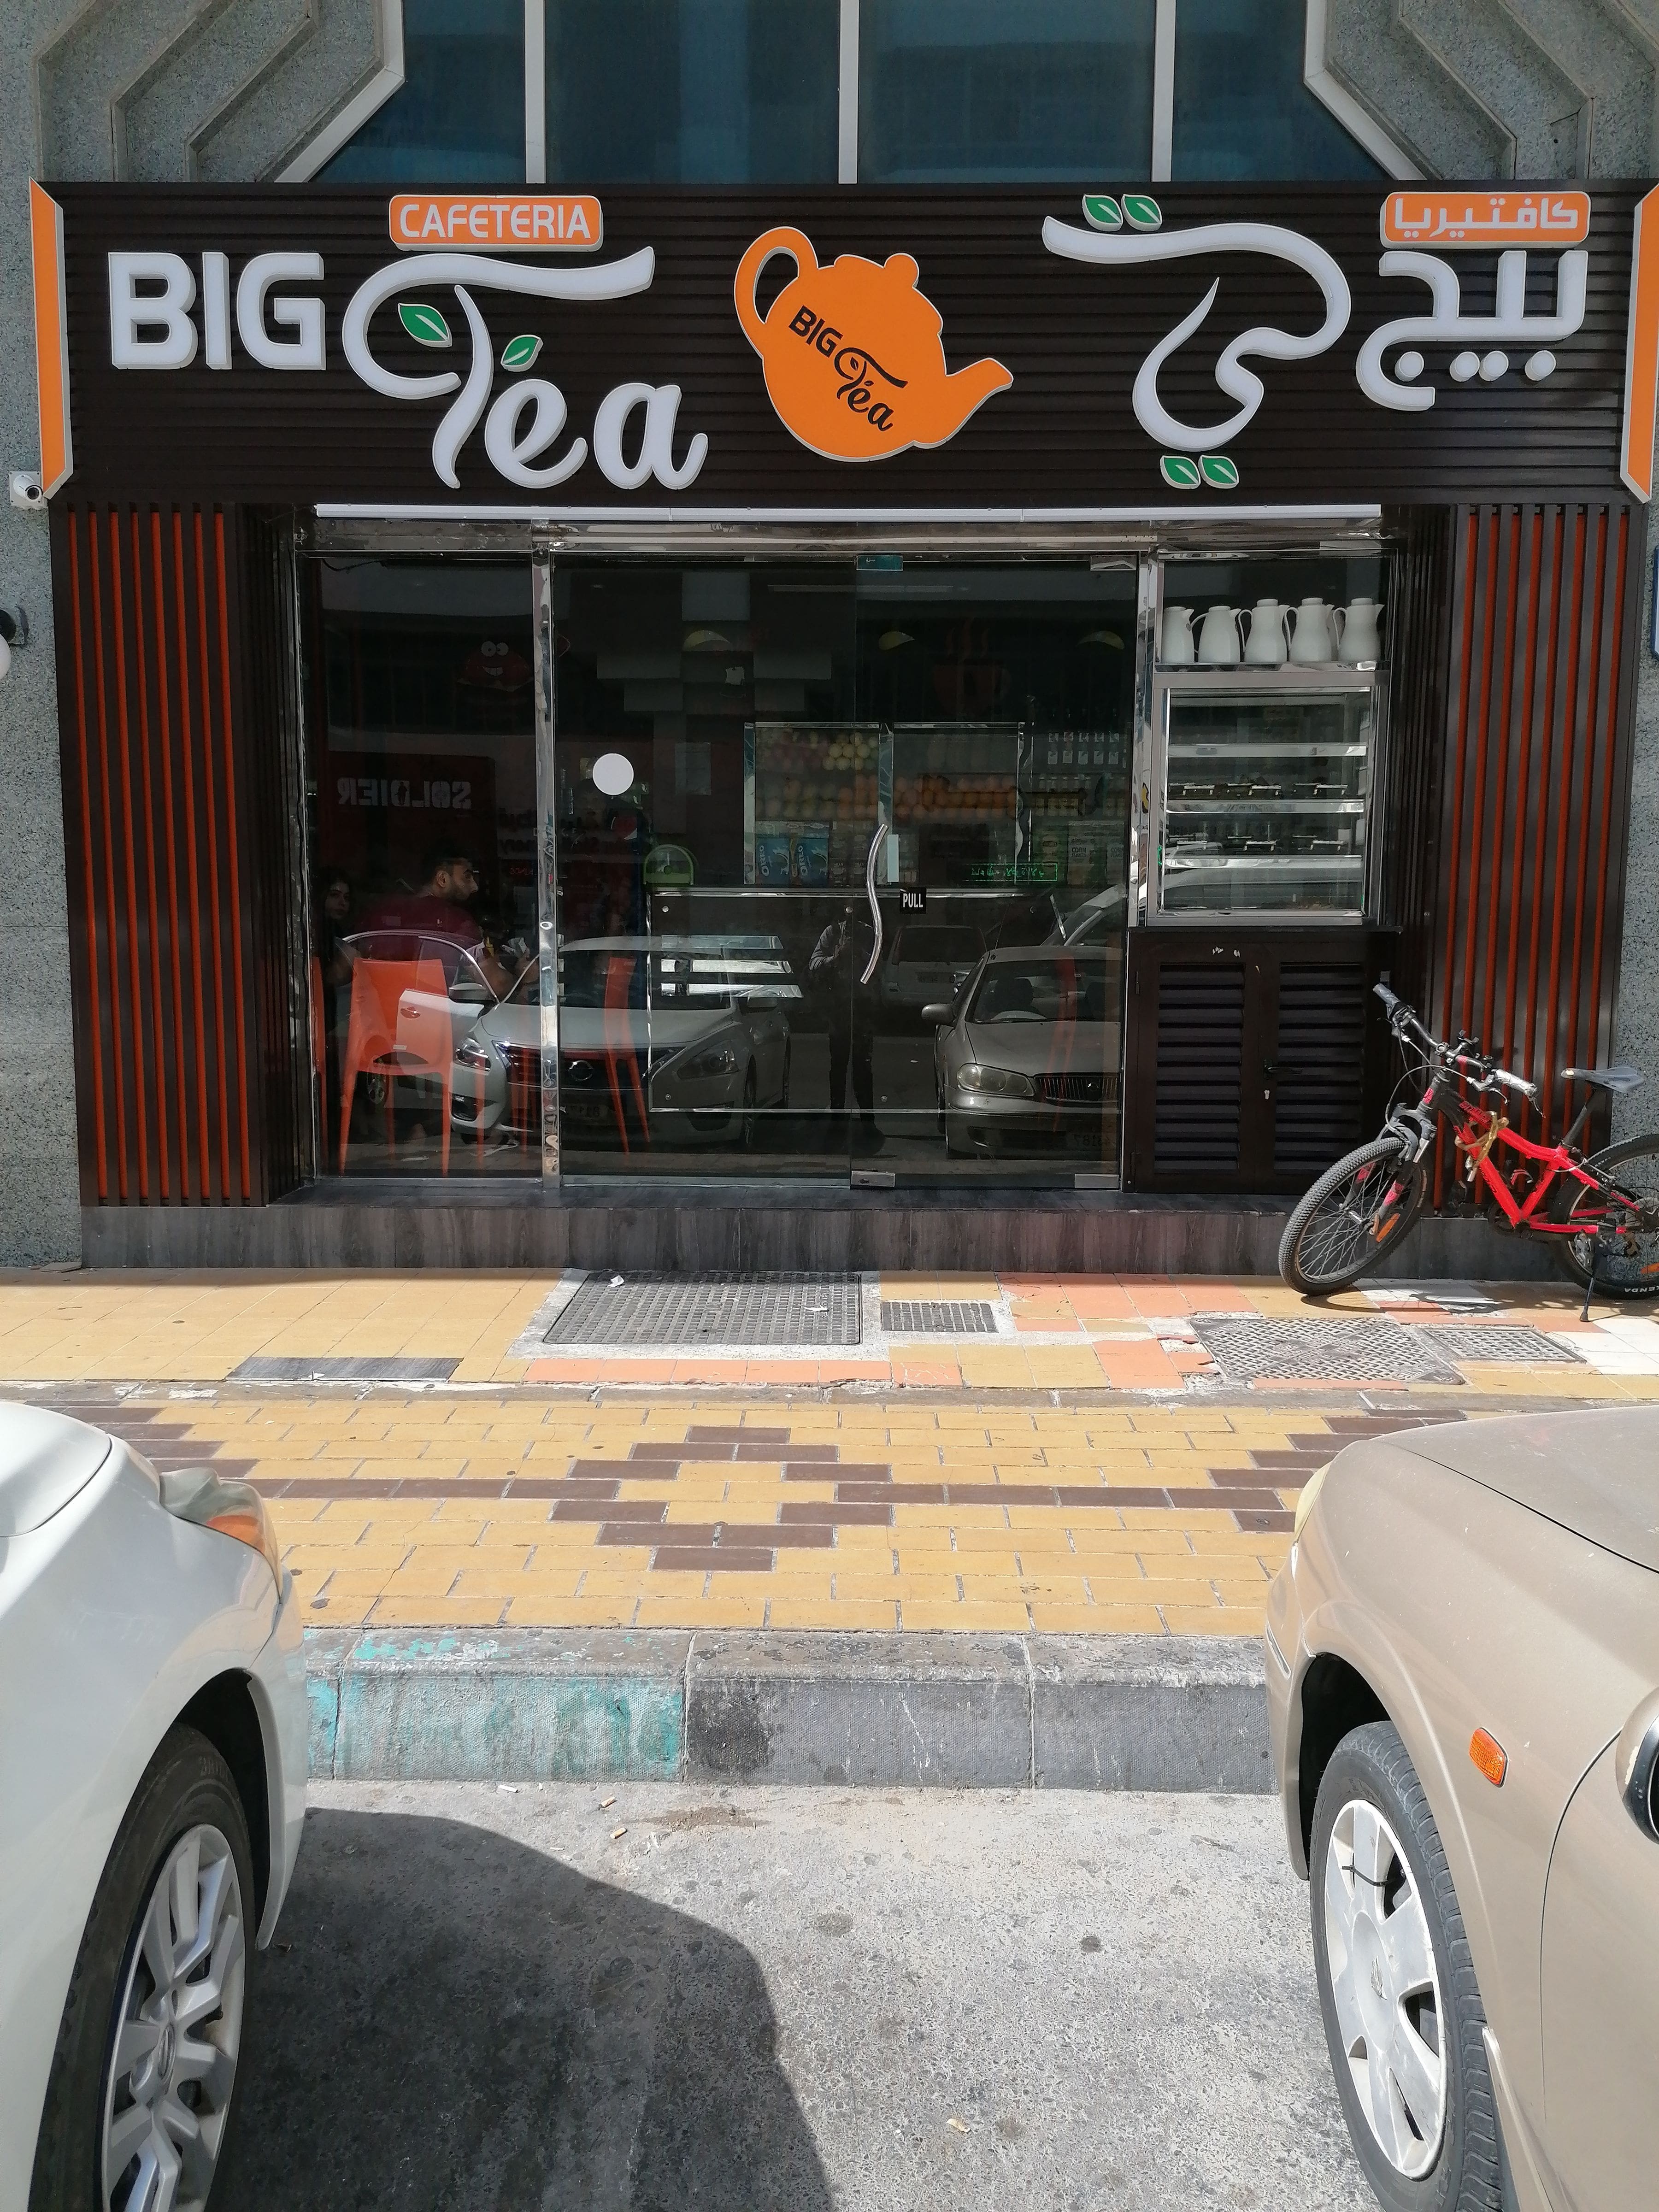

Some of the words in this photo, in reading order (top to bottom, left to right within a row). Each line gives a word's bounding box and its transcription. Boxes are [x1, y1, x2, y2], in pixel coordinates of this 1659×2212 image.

[399, 204, 591, 239] CAFETERIA
[1394, 197, 1578, 238] كافتيريا
[108, 251, 326, 371] BIG
[341, 245, 709, 490] Tea
[788, 305, 843, 358] BIG
[834, 347, 908, 432] Tea
[1041, 194, 1351, 489] تي
[1355, 250, 1588, 412] بيج
[903, 892, 924, 908] PULL
